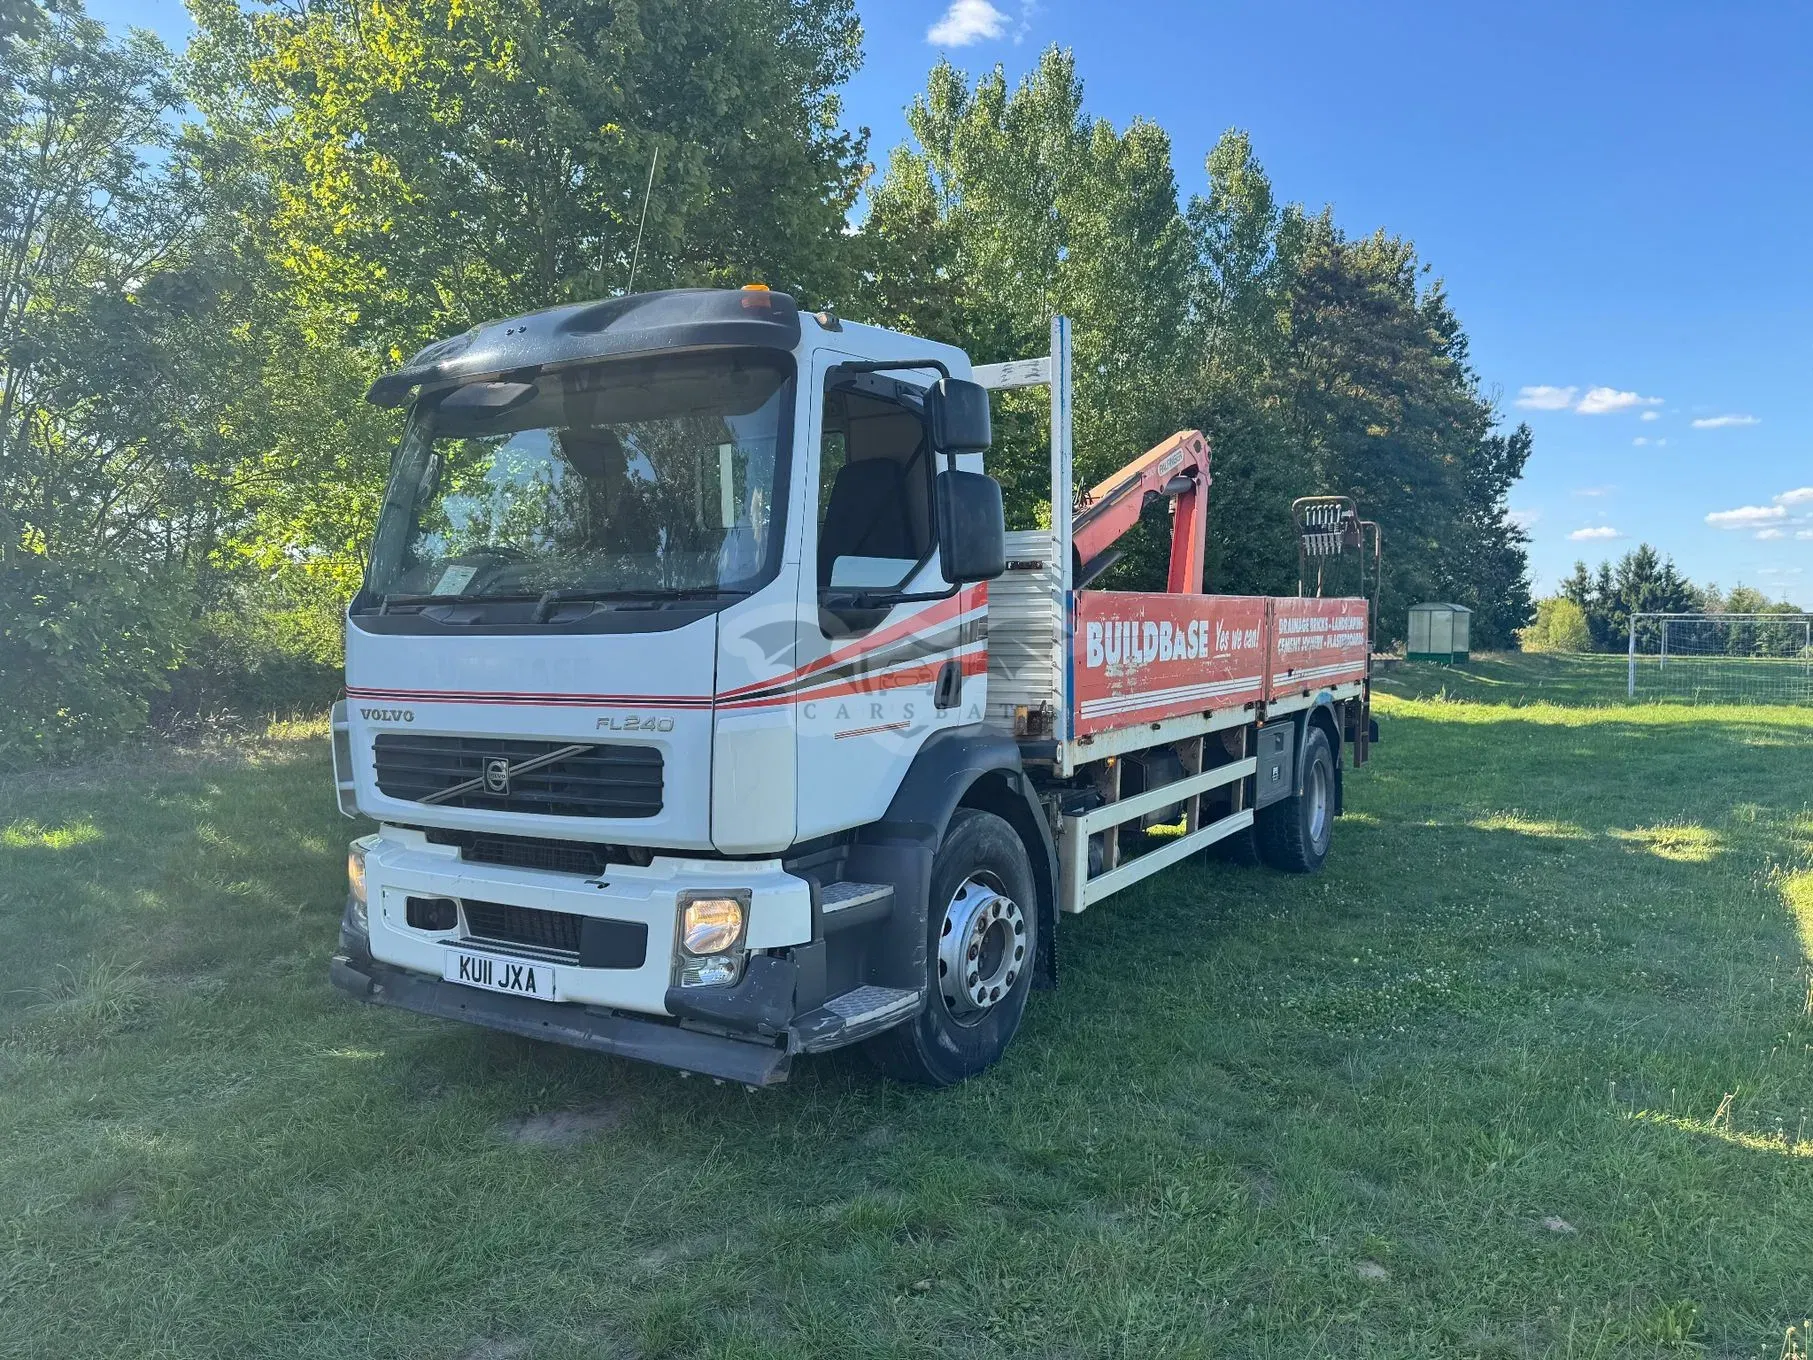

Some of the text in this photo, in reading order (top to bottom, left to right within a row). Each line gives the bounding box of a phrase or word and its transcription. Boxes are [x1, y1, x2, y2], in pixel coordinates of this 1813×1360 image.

[1086, 617, 1262, 668] BUILDBASE Yes we can!
[360, 708, 415, 723] VOLVO
[595, 715, 675, 733] FL240
[497, 963, 537, 994] JXA
